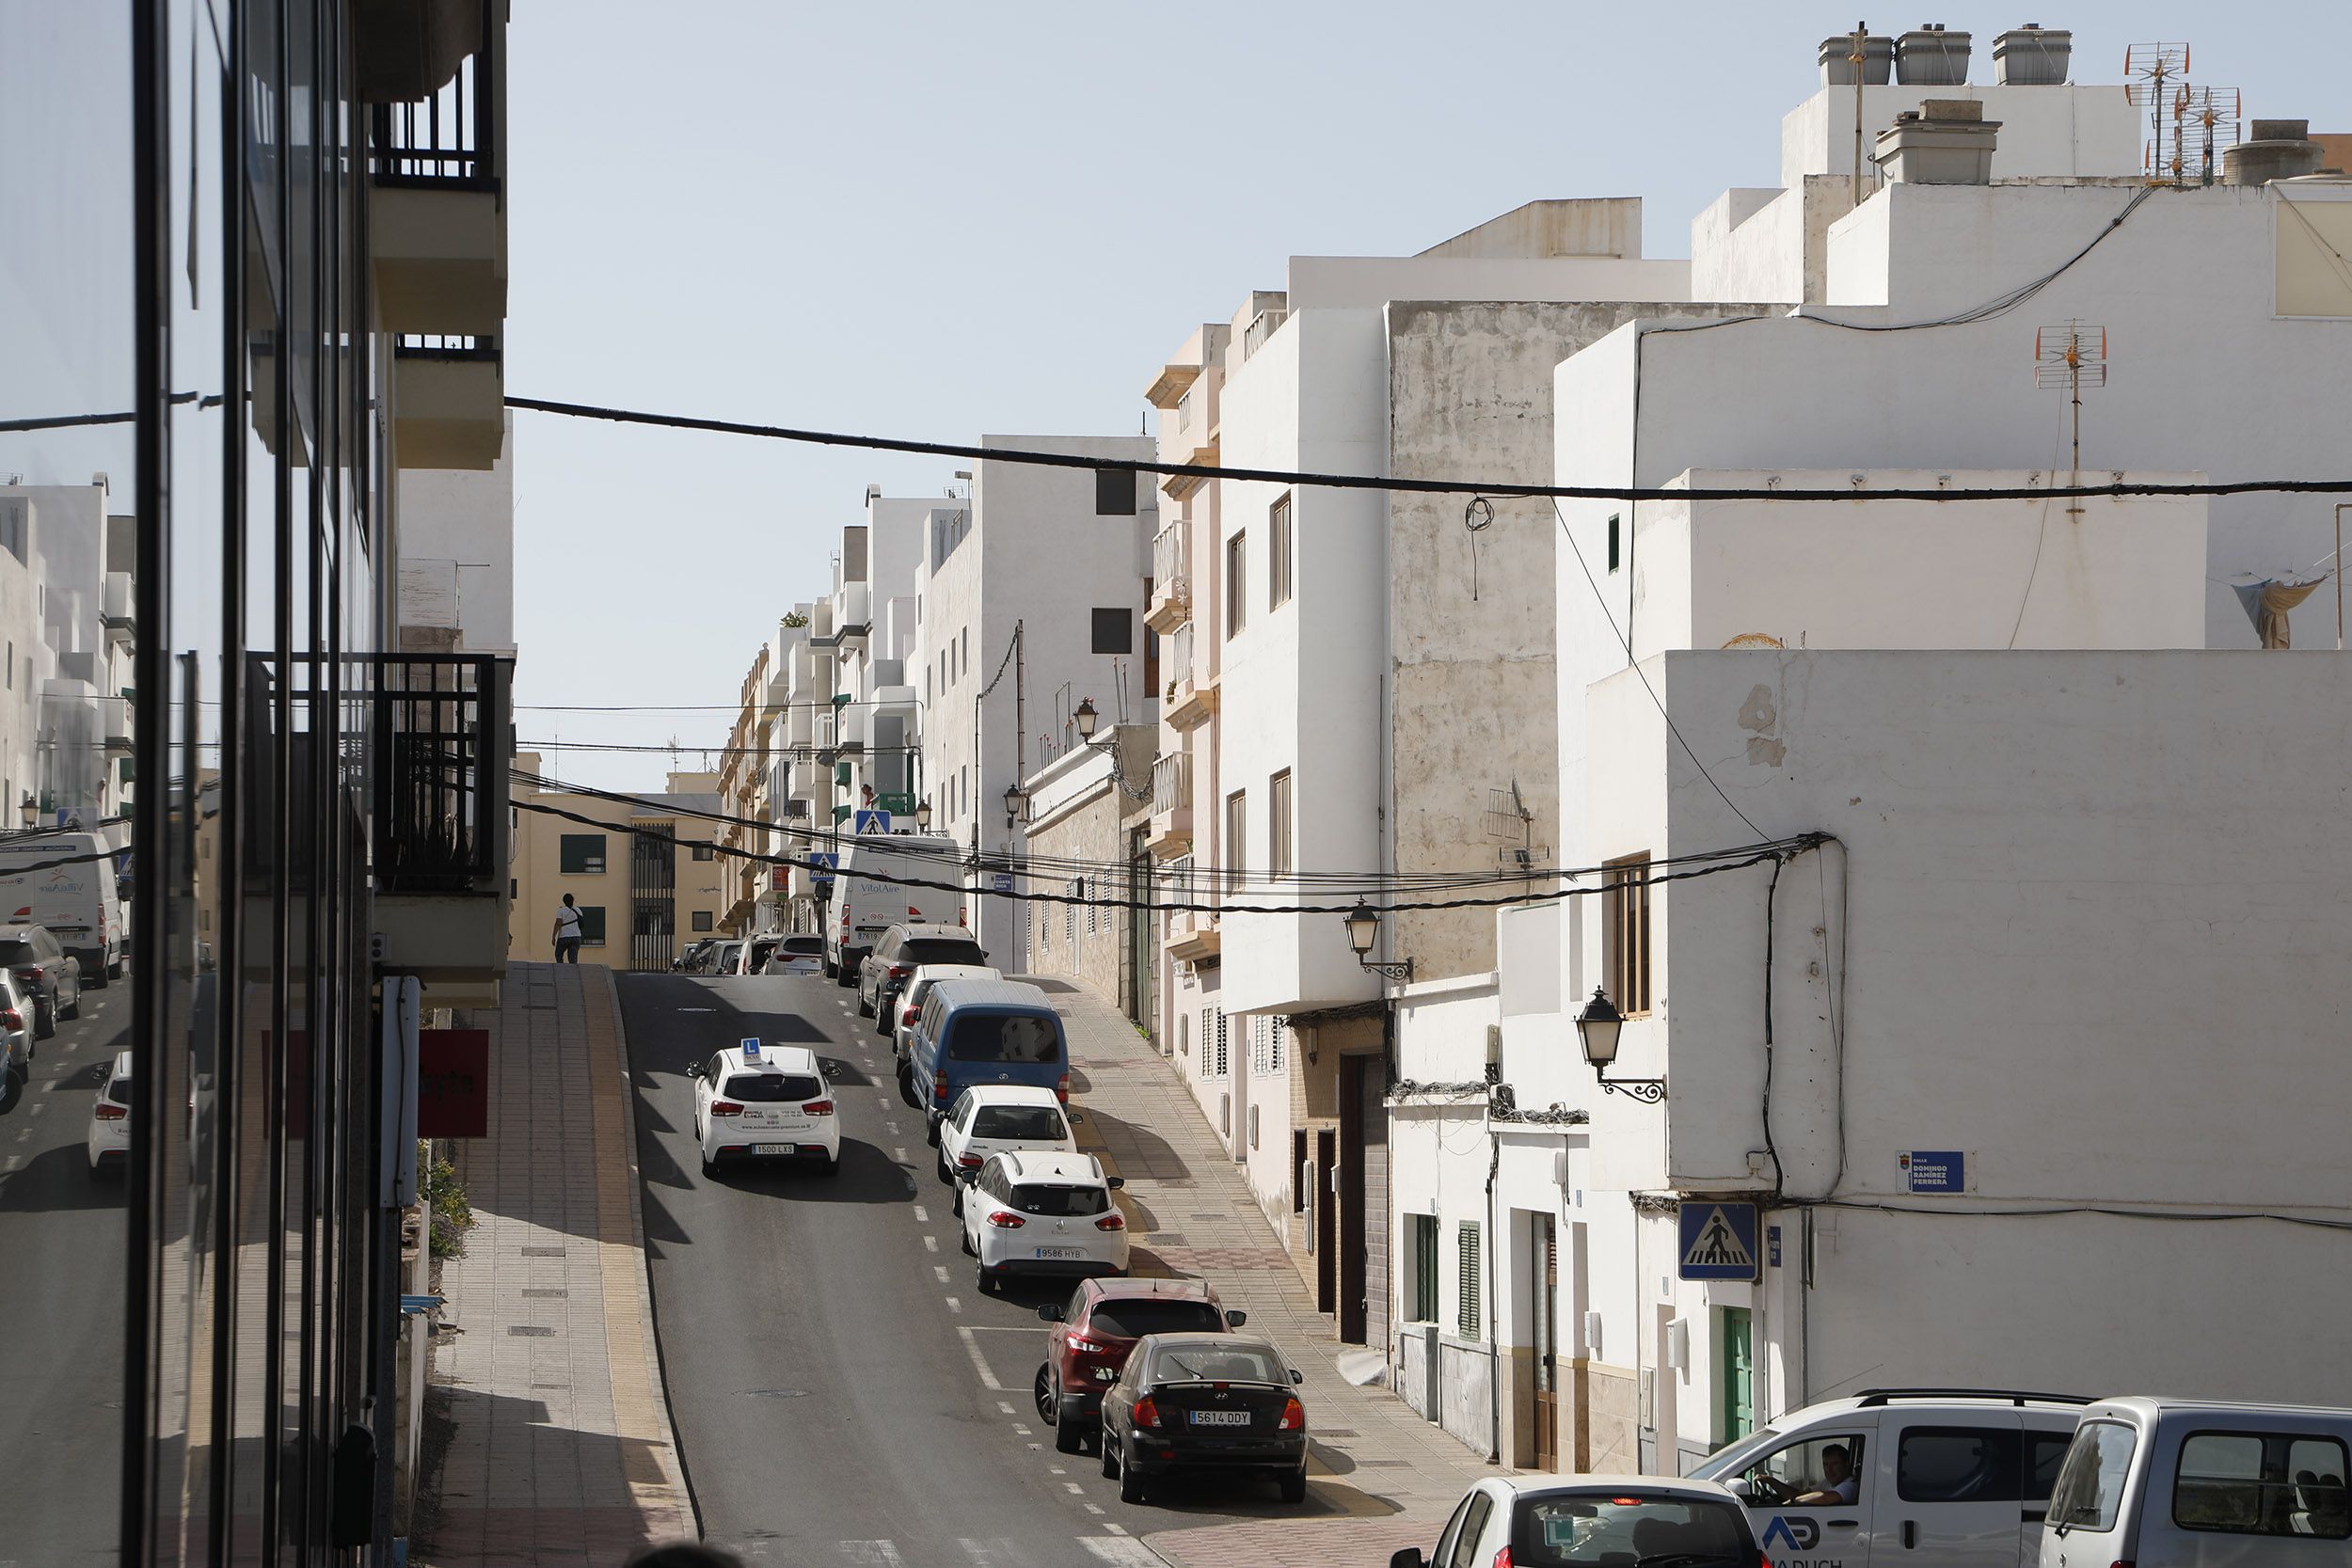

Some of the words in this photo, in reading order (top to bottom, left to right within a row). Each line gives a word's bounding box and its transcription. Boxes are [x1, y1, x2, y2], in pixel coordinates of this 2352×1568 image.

[747, 1041, 755, 1053] L
[1042, 1249, 1063, 1258] 9586
[1198, 1412, 1224, 1422] 5614
[1227, 1413, 1248, 1423] DDY
